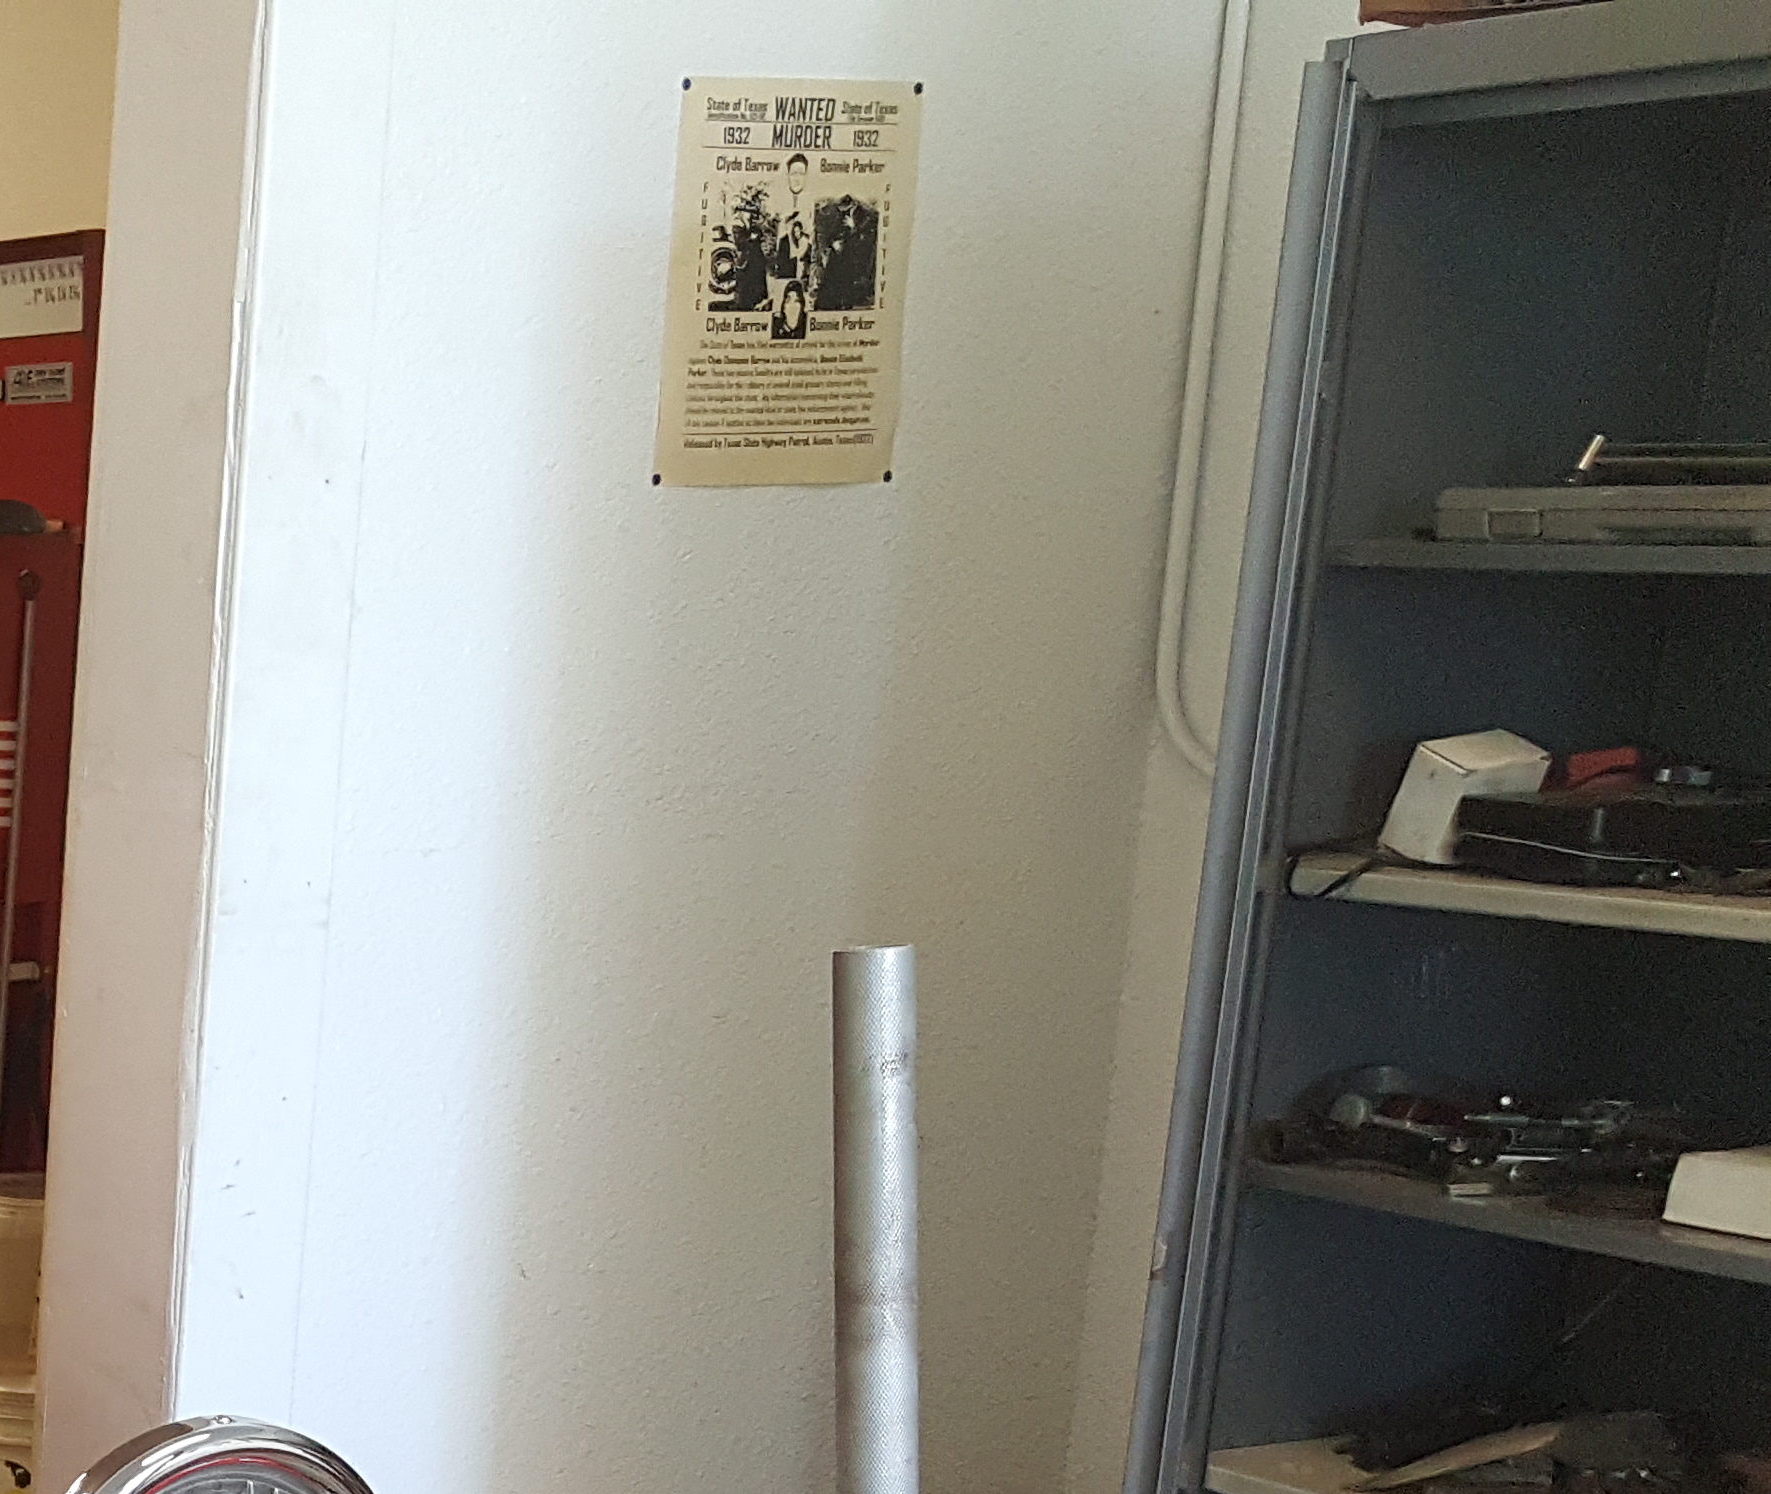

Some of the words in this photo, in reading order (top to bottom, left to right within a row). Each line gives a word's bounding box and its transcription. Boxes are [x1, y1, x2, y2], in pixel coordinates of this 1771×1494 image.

[706, 97, 730, 112] State
[732, 97, 742, 112] of
[743, 97, 768, 112] Texas
[774, 96, 836, 122] WANTED
[841, 101, 862, 114] State
[864, 101, 873, 114] of
[875, 101, 898, 115] Texas
[723, 126, 751, 145] 1932
[771, 125, 832, 149] MURDER
[852, 130, 880, 148] 1932
[716, 156, 743, 174] Clyde
[745, 156, 780, 172] Barrow
[820, 157, 849, 174] Bonnie
[852, 158, 885, 174] Parker
[705, 317, 732, 335] Clyde
[733, 317, 768, 333] Barrow
[809, 317, 840, 332] Bonnie
[842, 316, 875, 331] Parker
